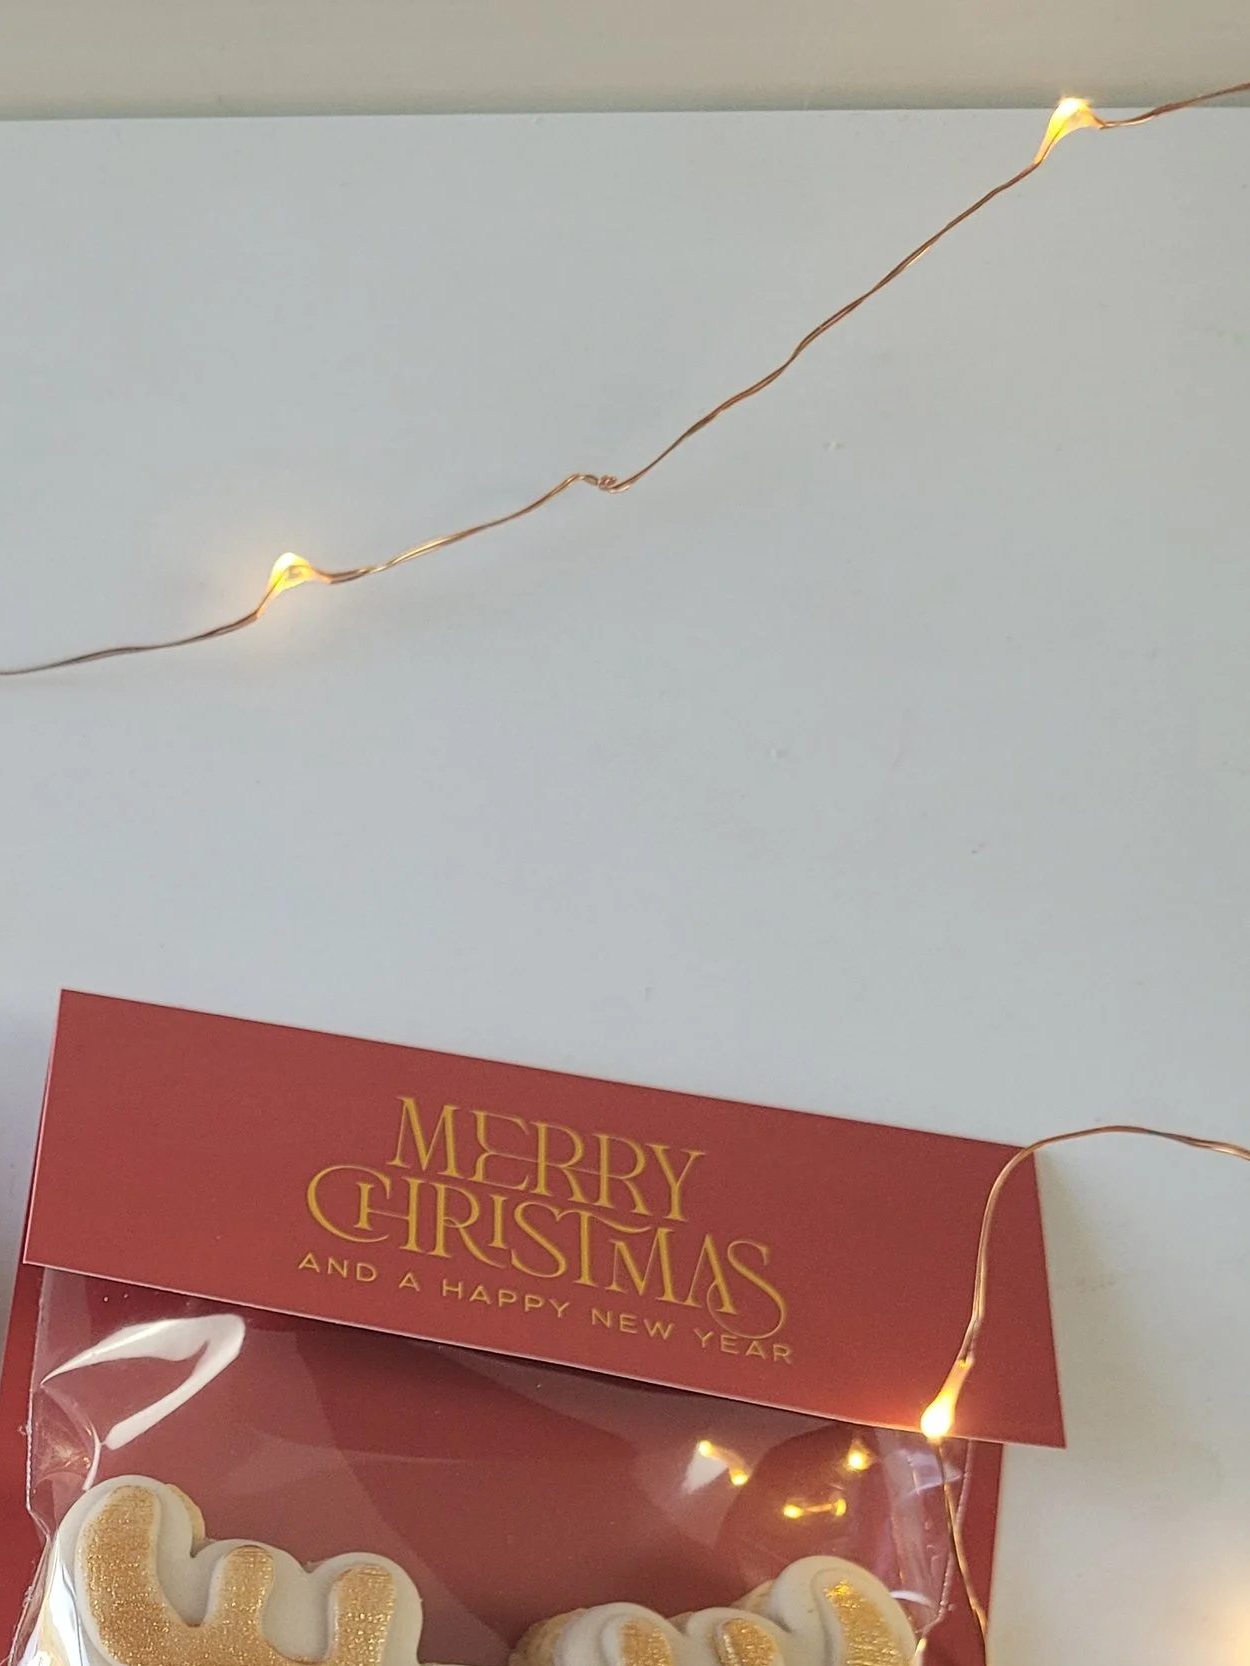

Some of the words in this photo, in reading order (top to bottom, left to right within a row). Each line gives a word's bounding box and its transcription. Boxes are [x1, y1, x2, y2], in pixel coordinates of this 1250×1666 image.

[387, 1096, 706, 1222] MERRY
[298, 1252, 377, 1283] AND
[399, 1272, 420, 1291] A
[442, 1280, 570, 1318] HAPPY
[591, 1309, 674, 1340] NEW
[694, 1328, 793, 1364] YEAR
[306, 1164, 787, 1339] CHRISTMAS
